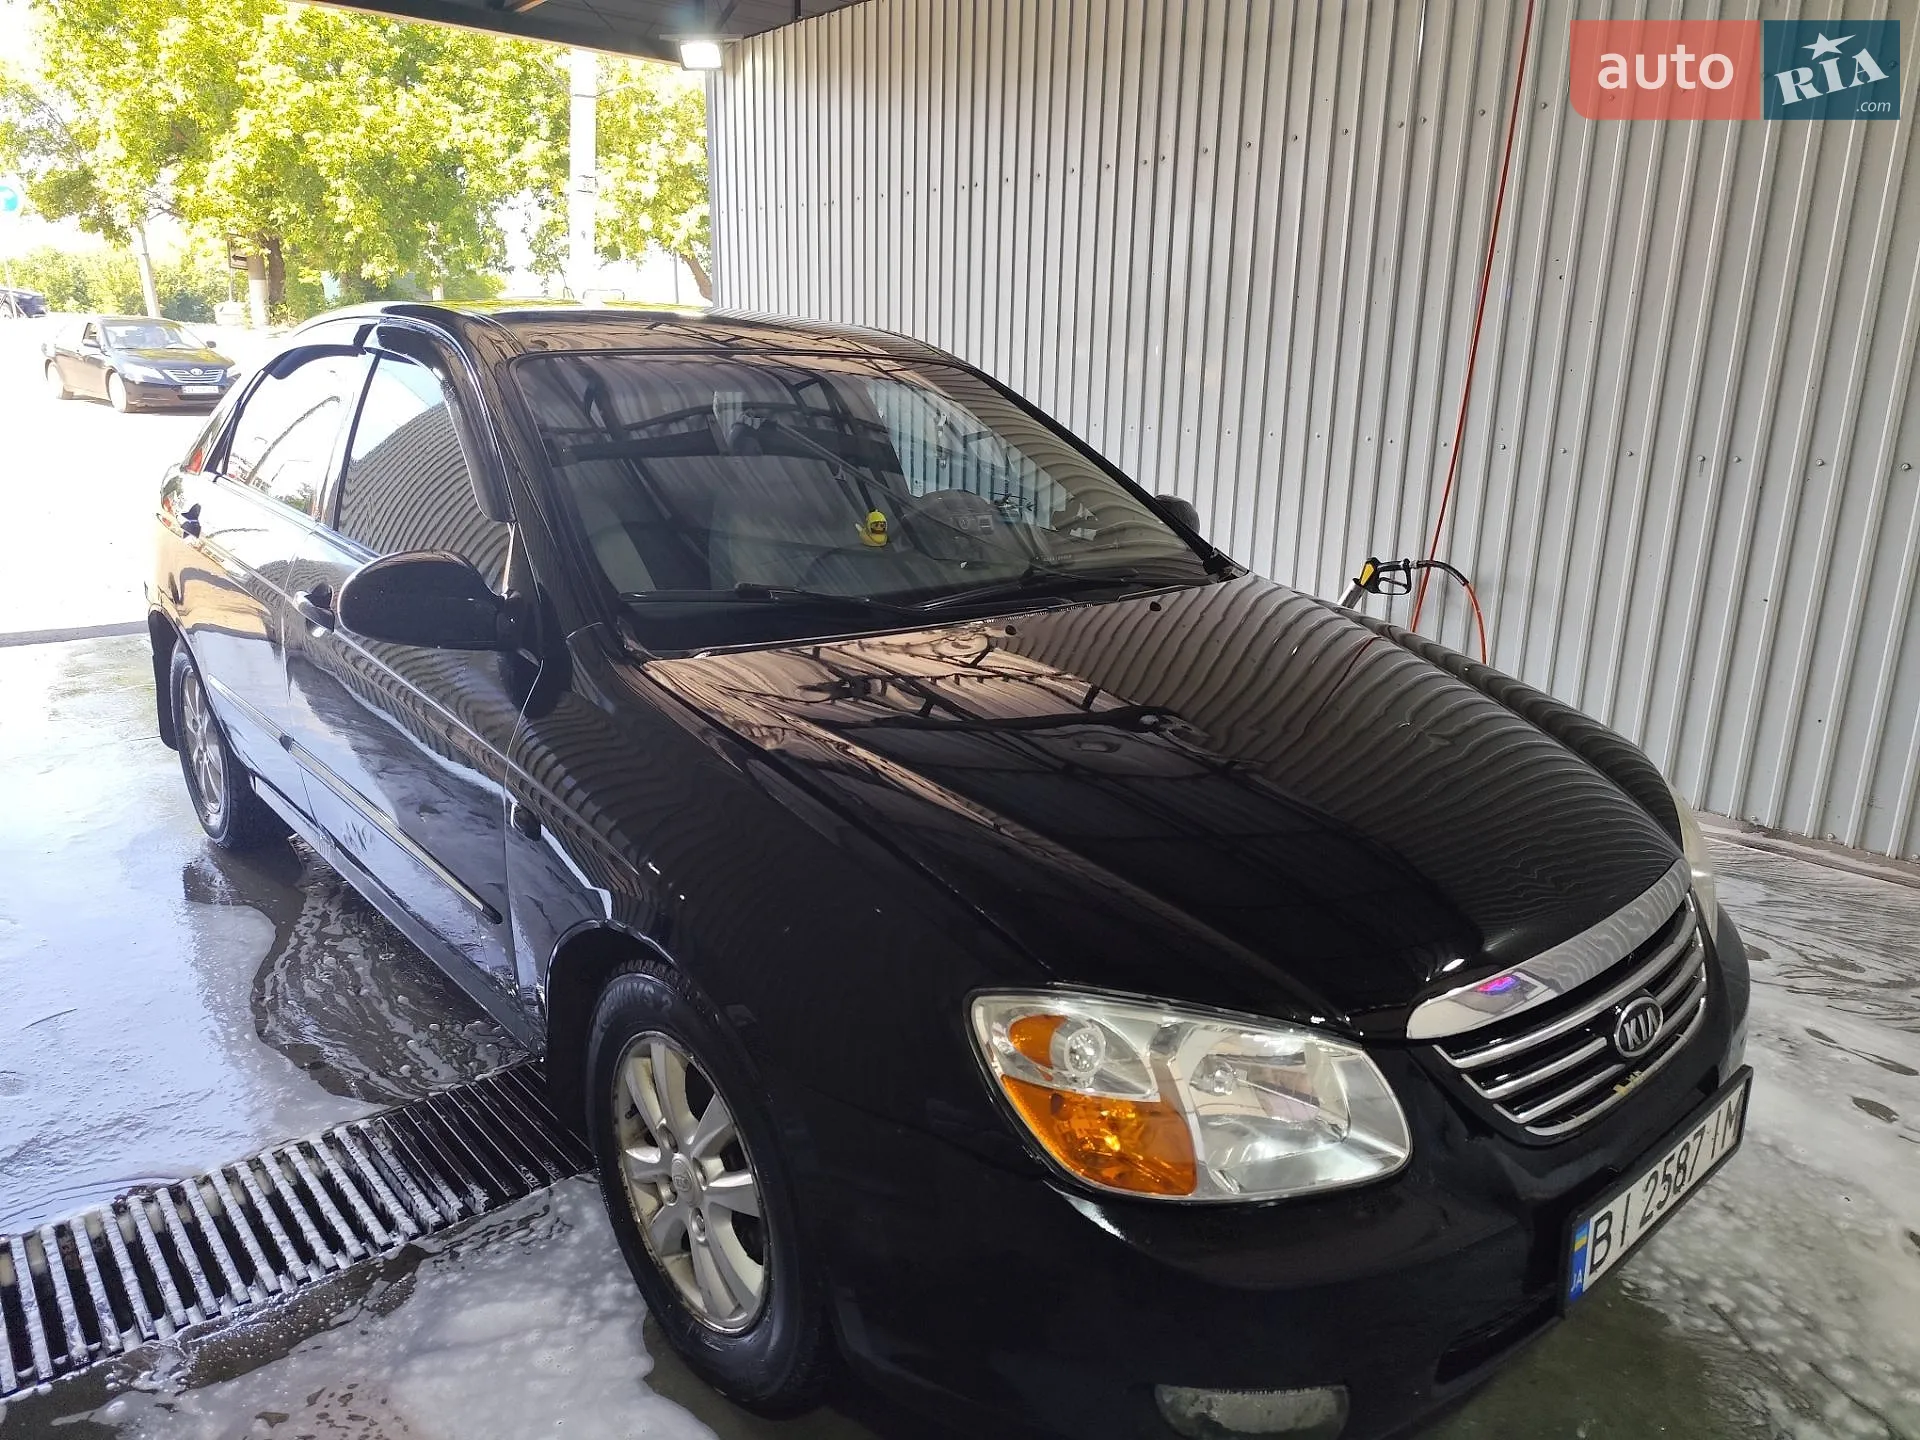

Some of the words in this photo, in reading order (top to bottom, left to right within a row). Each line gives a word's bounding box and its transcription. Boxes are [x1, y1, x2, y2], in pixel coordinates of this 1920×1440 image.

[1623, 1006, 1659, 1051] KIA
[1590, 1191, 1631, 1276] BI
[1639, 1124, 1706, 1230] 2587
[1711, 1089, 1744, 1160] IM
